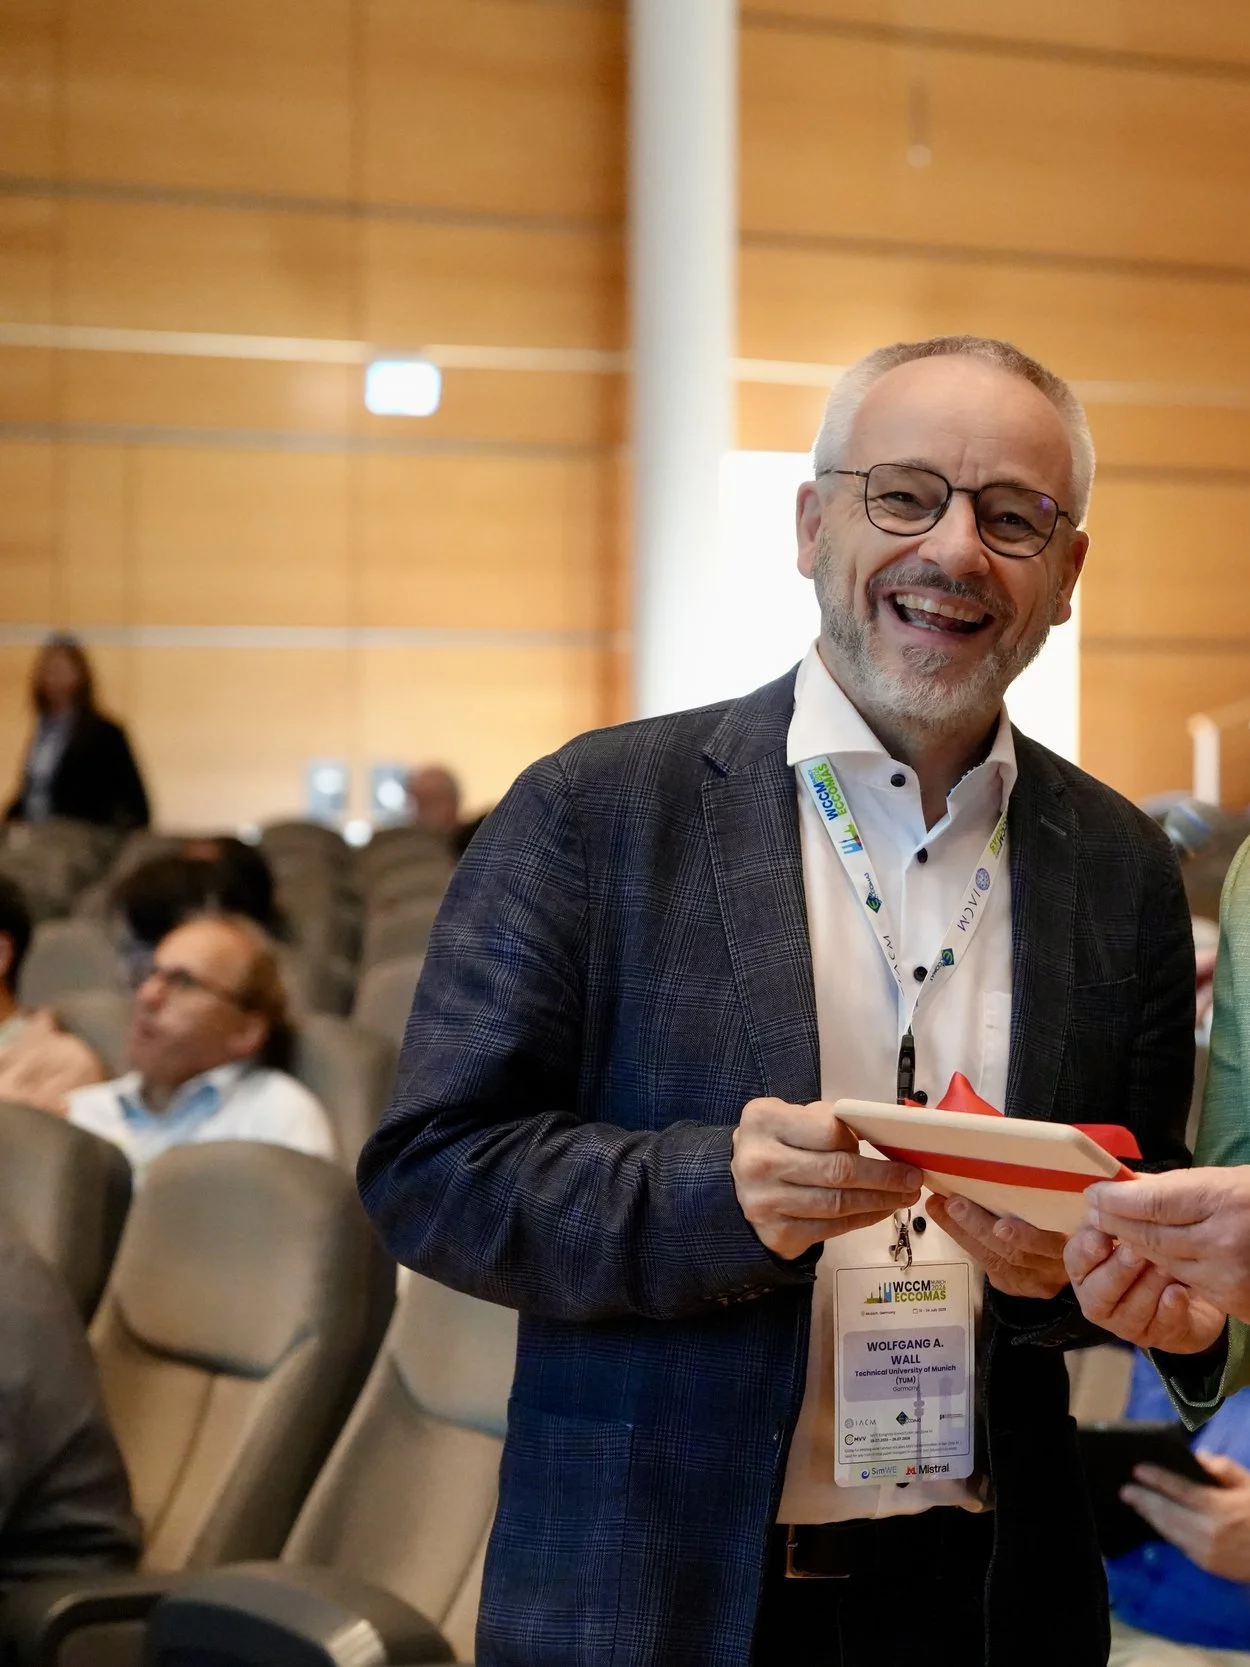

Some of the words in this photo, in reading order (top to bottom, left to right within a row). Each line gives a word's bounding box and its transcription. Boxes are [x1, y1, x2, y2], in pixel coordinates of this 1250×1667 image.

[818, 763, 847, 816] ECCOMAS
[813, 781, 838, 821] WCCM
[957, 888, 982, 932] IACM
[893, 1280, 930, 1292] WCCM
[894, 1291, 946, 1302] ECCOMAS
[867, 1340, 930, 1352] WOLFGANG
[934, 1338, 944, 1348] A.
[891, 1355, 920, 1365] WALL
[896, 1376, 916, 1384] (TUM)
[872, 1466, 897, 1475] SimWE
[919, 1464, 949, 1474] Mistral
